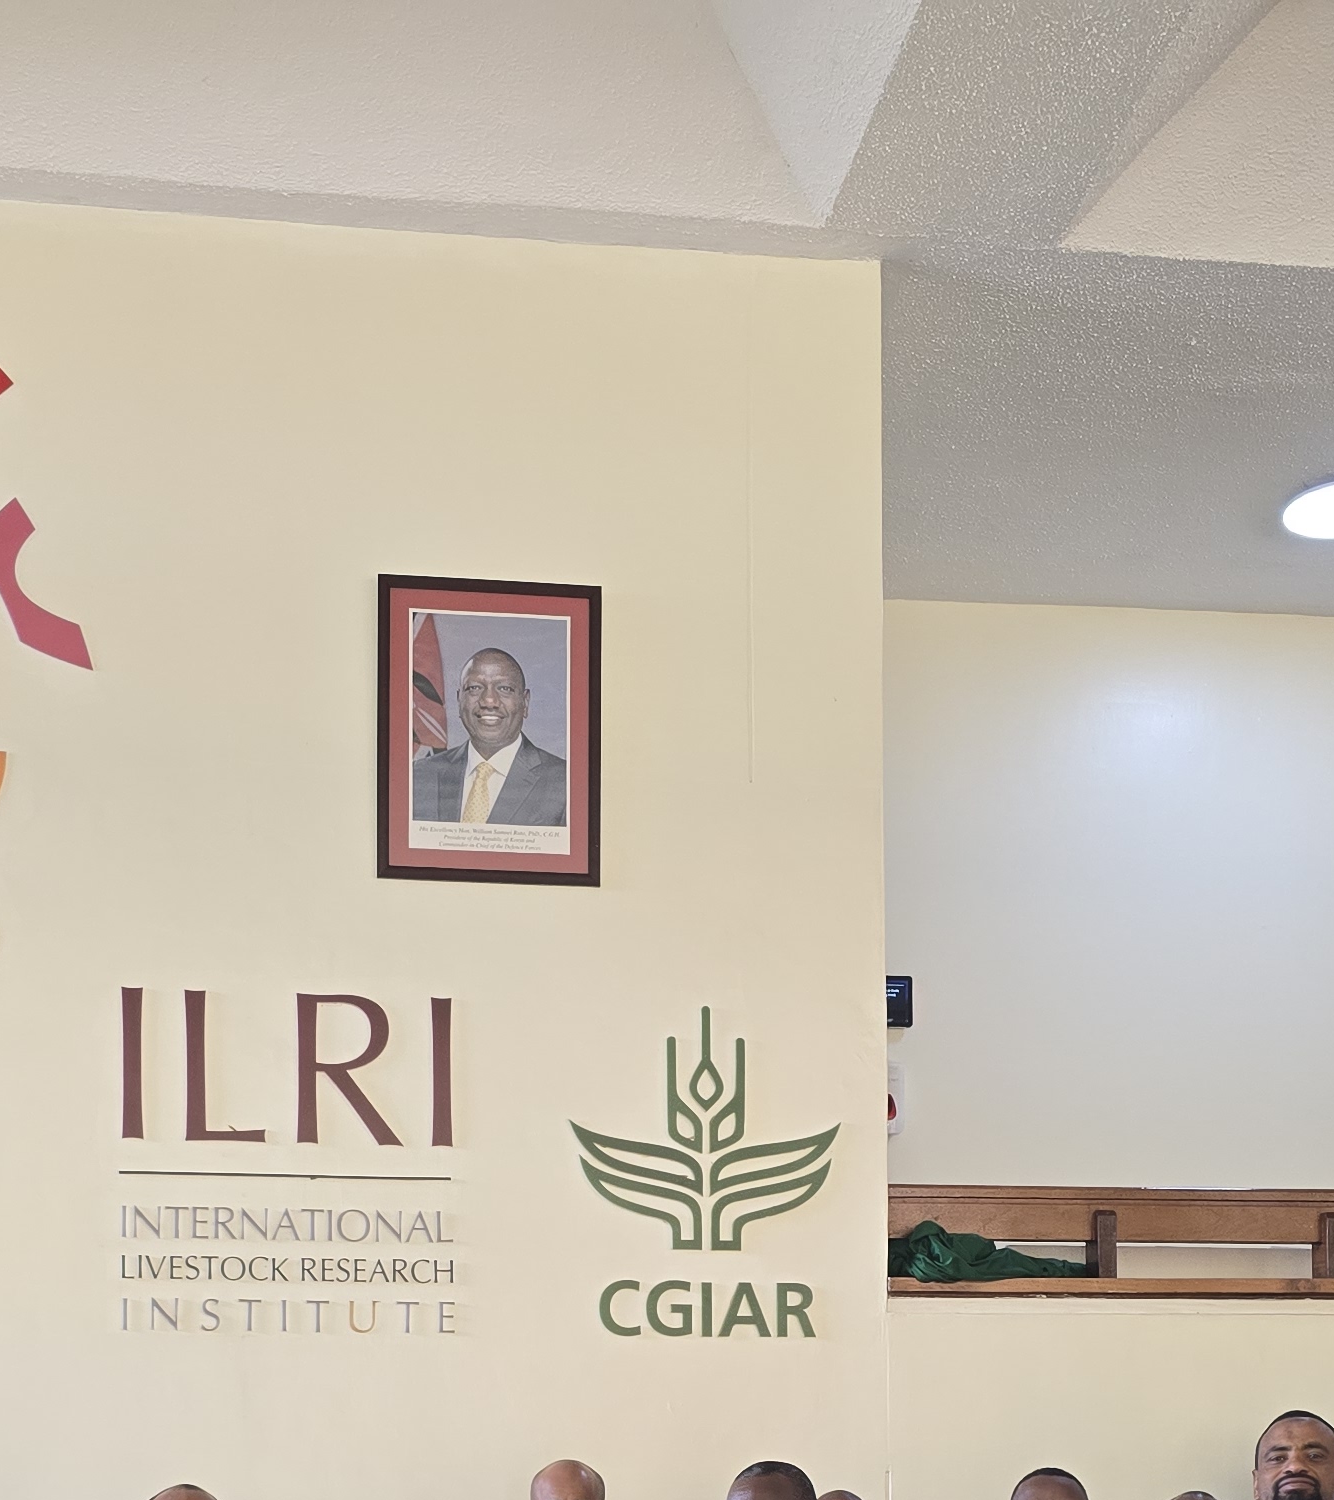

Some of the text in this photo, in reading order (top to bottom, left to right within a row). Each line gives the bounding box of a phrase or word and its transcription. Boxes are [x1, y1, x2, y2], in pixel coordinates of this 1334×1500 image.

[120, 986, 453, 1148] ILRI
[120, 1206, 454, 1244] INTERNATIONAL
[120, 1255, 455, 1284] LIVESTOCK RESEARCH
[120, 1299, 456, 1334] INSTITUTE
[598, 1280, 817, 1339] CGIAR
